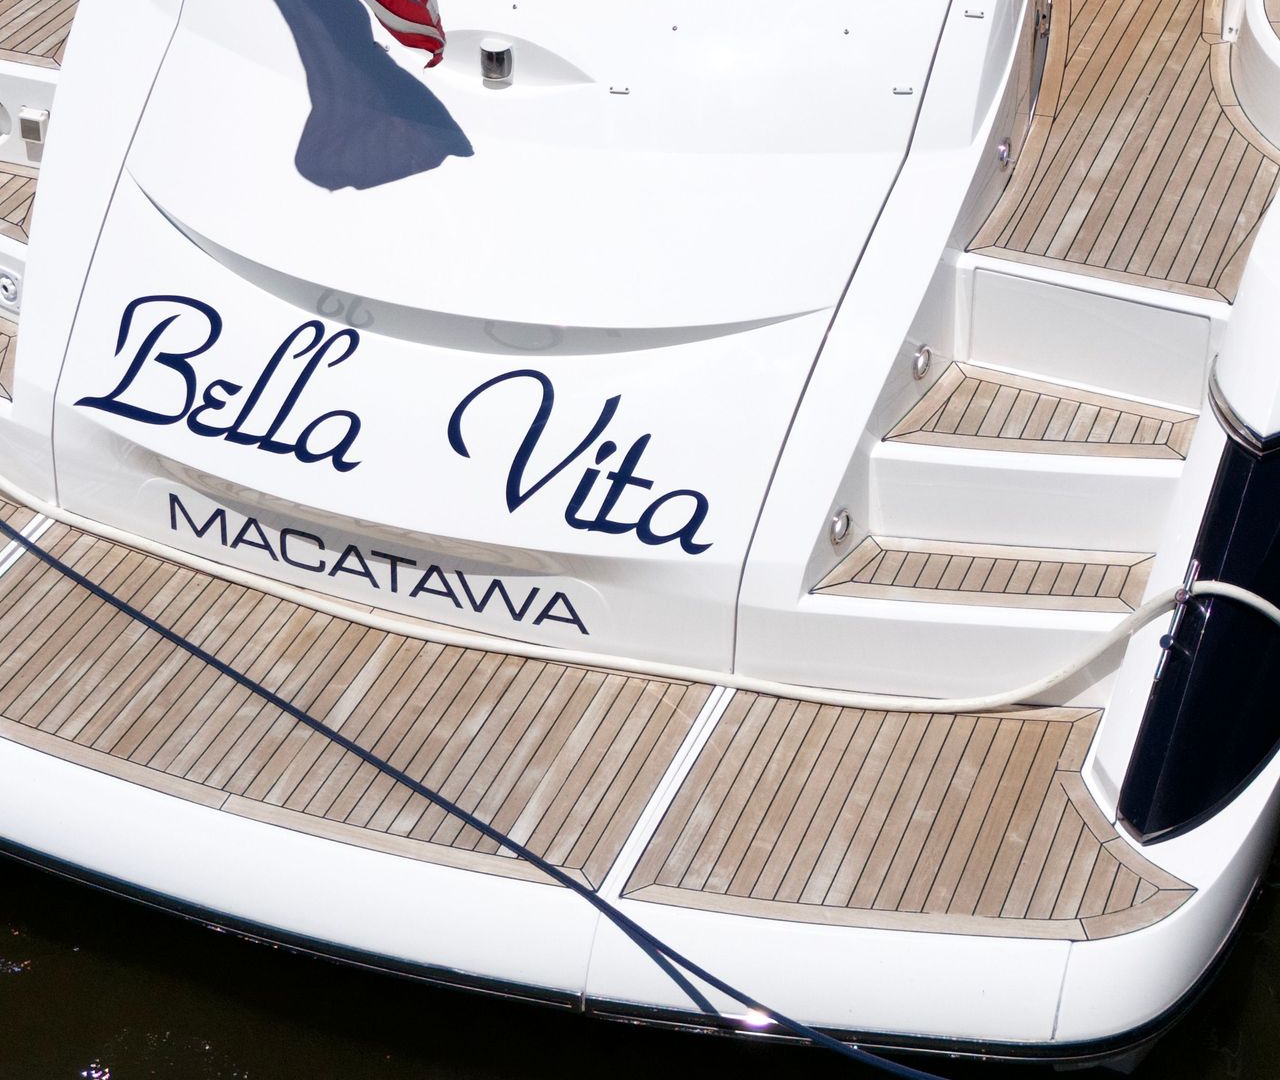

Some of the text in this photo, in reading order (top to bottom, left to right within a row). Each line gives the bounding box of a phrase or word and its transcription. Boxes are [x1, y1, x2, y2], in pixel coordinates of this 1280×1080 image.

[73, 294, 714, 555] Bella Vita
[168, 492, 590, 635] MACATAWA
